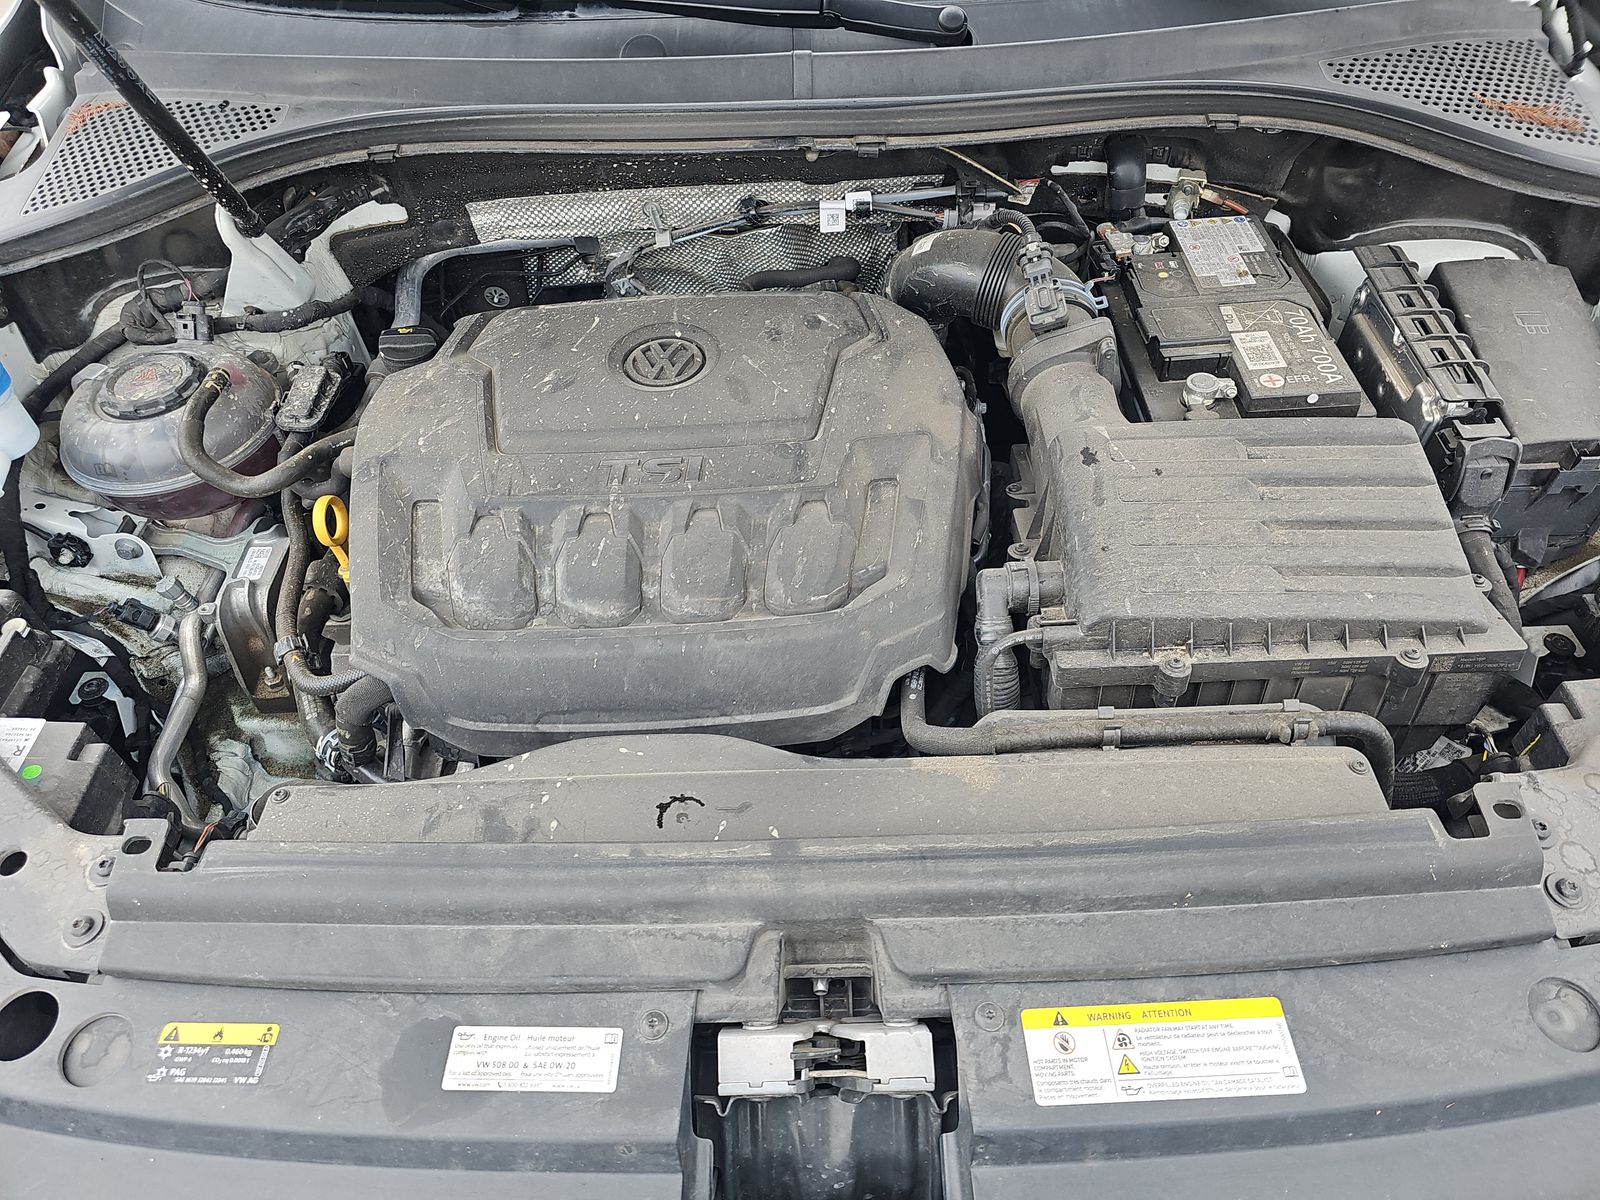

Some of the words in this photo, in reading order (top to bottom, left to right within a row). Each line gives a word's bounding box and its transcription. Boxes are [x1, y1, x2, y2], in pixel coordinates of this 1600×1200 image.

[1285, 309, 1318, 343] 70Ah
[1307, 346, 1344, 384] 700A
[624, 338, 704, 386] VW
[1285, 375, 1320, 384] EFB+
[598, 456, 704, 486] TSI
[13, 745, 26, 756] R
[1087, 1012, 1132, 1021] WARNING
[1142, 1008, 1192, 1018] ATTENTION
[483, 1033, 508, 1043] Engine
[510, 1033, 521, 1041] Oil
[527, 1034, 546, 1042] Huile
[177, 1046, 211, 1056] R-1234yf
[244, 1048, 253, 1057] kg
[492, 1061, 507, 1069] 508
[508, 1061, 519, 1069] 00
[533, 1061, 547, 1069] SAE
[549, 1061, 576, 1070] 0W-20
[169, 1068, 187, 1076] PAG
[234, 1076, 246, 1084] VW
[246, 1076, 259, 1084] AG
